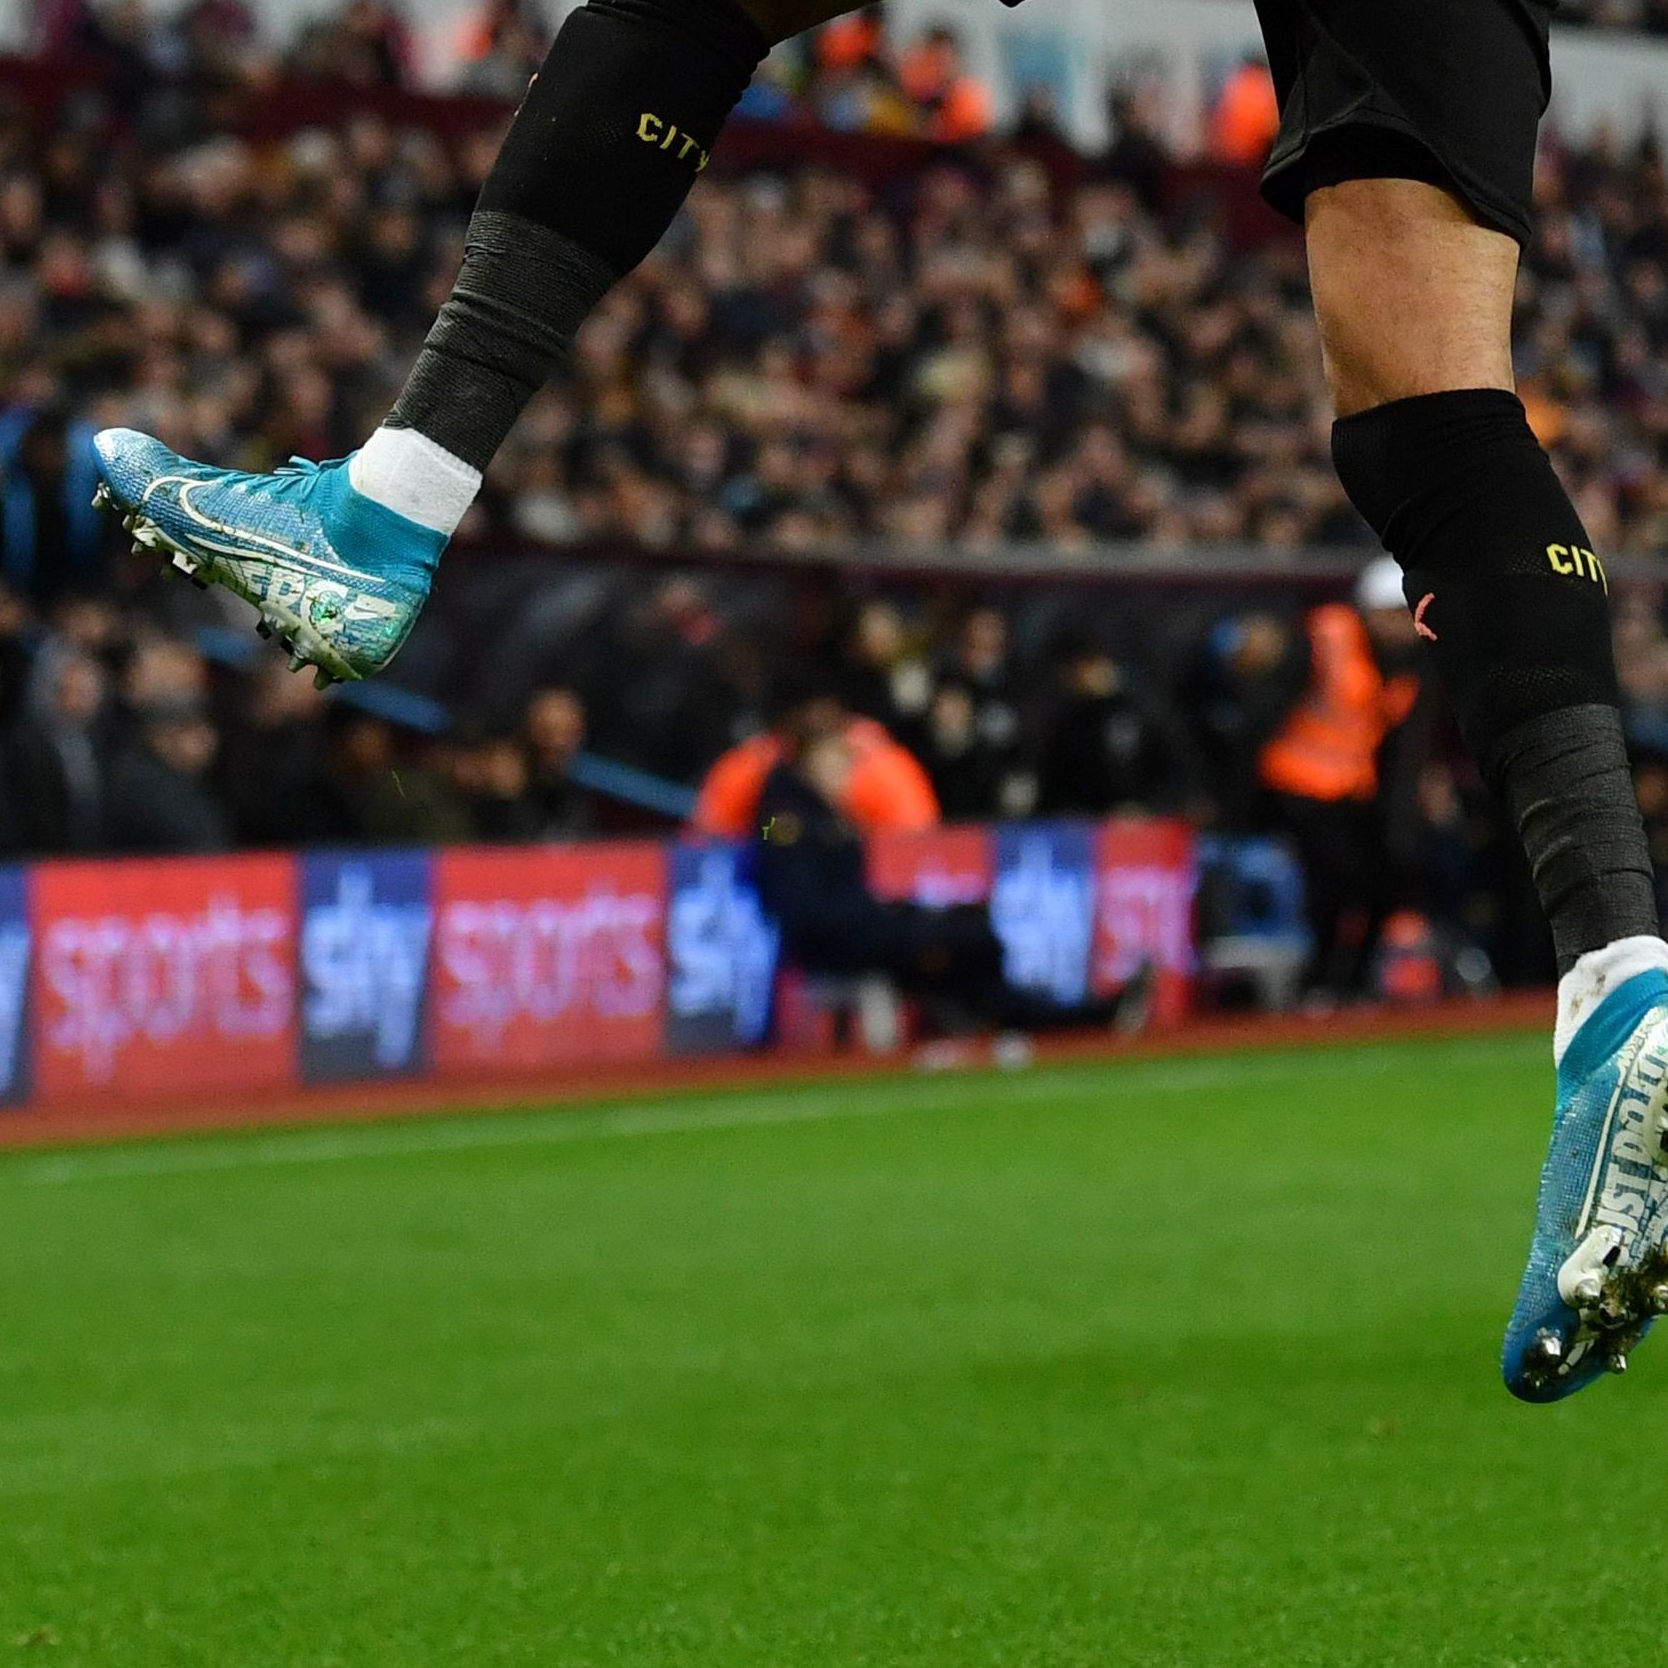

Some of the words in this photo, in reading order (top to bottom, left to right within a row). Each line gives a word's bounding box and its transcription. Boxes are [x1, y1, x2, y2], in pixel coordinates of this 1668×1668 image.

[636, 113, 710, 173] CITY
[1546, 543, 1609, 597] CIT
[42, 894, 290, 1084] sports
[302, 863, 431, 1069] sky
[438, 877, 662, 1060] sports
